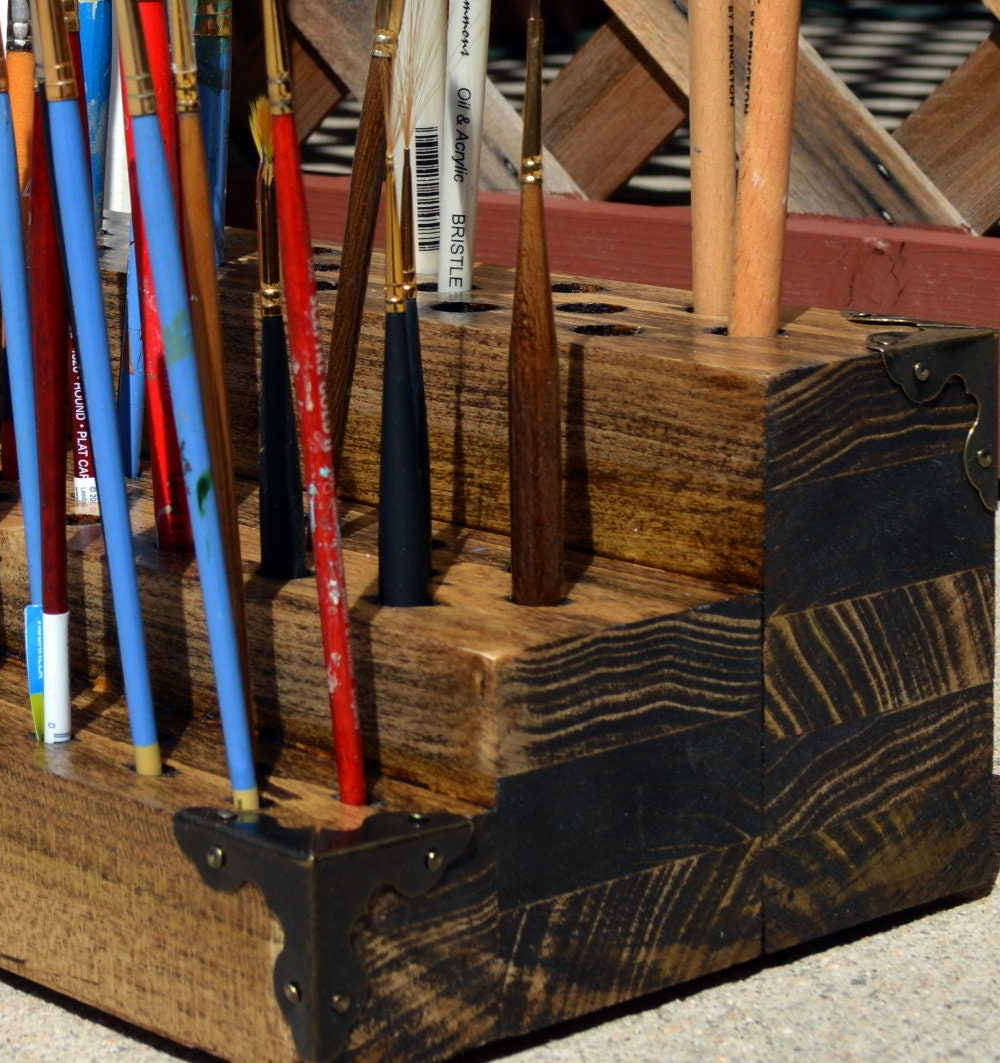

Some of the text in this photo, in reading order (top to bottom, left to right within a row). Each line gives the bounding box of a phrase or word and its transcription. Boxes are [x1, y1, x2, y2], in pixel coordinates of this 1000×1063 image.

[451, 87, 471, 183] Oil & Acrylic
[448, 214, 466, 288] BRISTLE
[76, 431, 89, 457] PLAT
